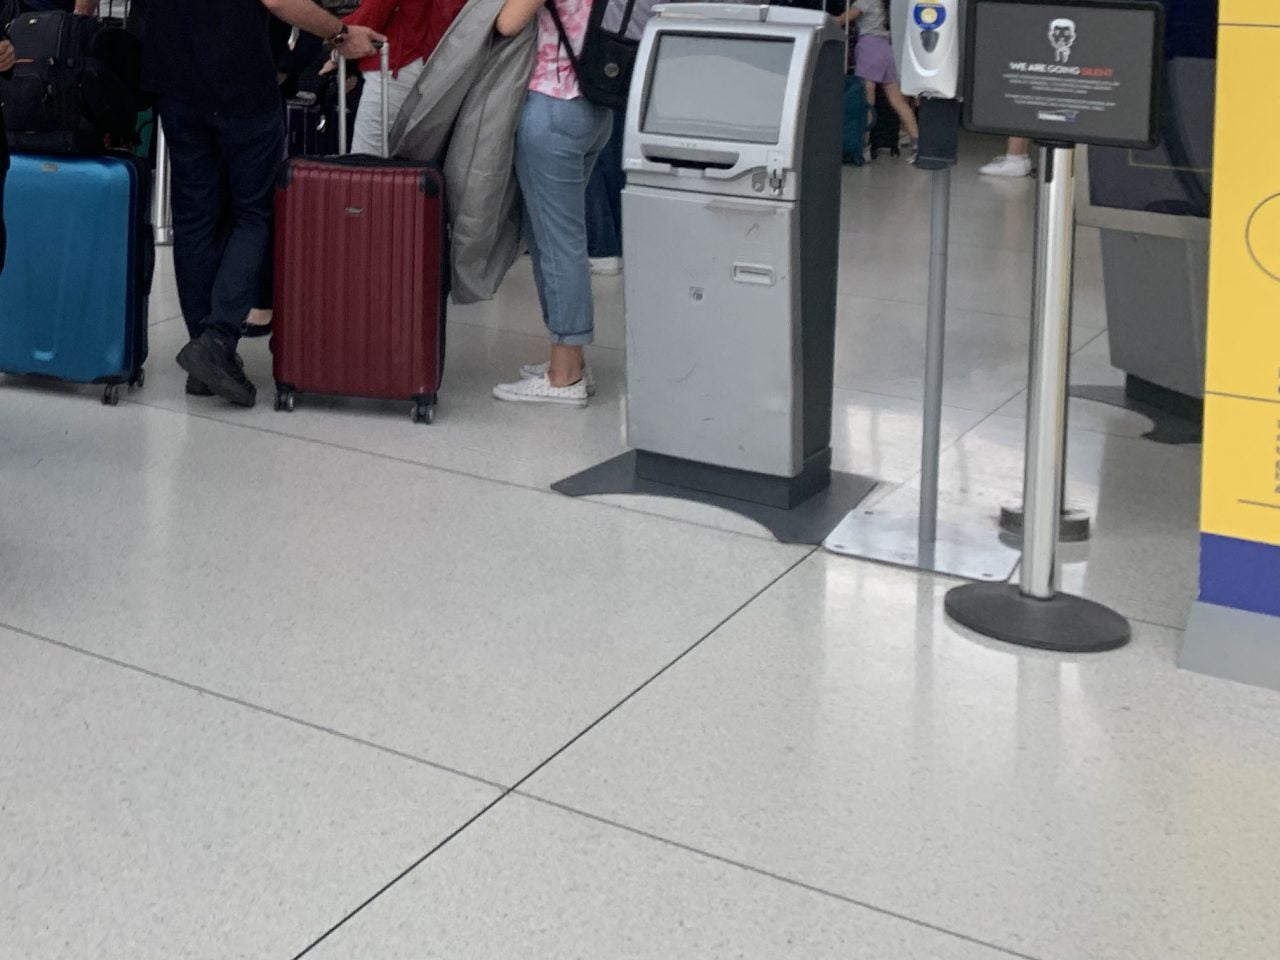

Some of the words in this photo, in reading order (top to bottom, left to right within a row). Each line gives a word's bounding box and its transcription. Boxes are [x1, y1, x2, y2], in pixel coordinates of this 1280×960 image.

[1009, 61, 1026, 70] WE
[1028, 63, 1046, 72] ARE
[1047, 64, 1080, 75] GOING
